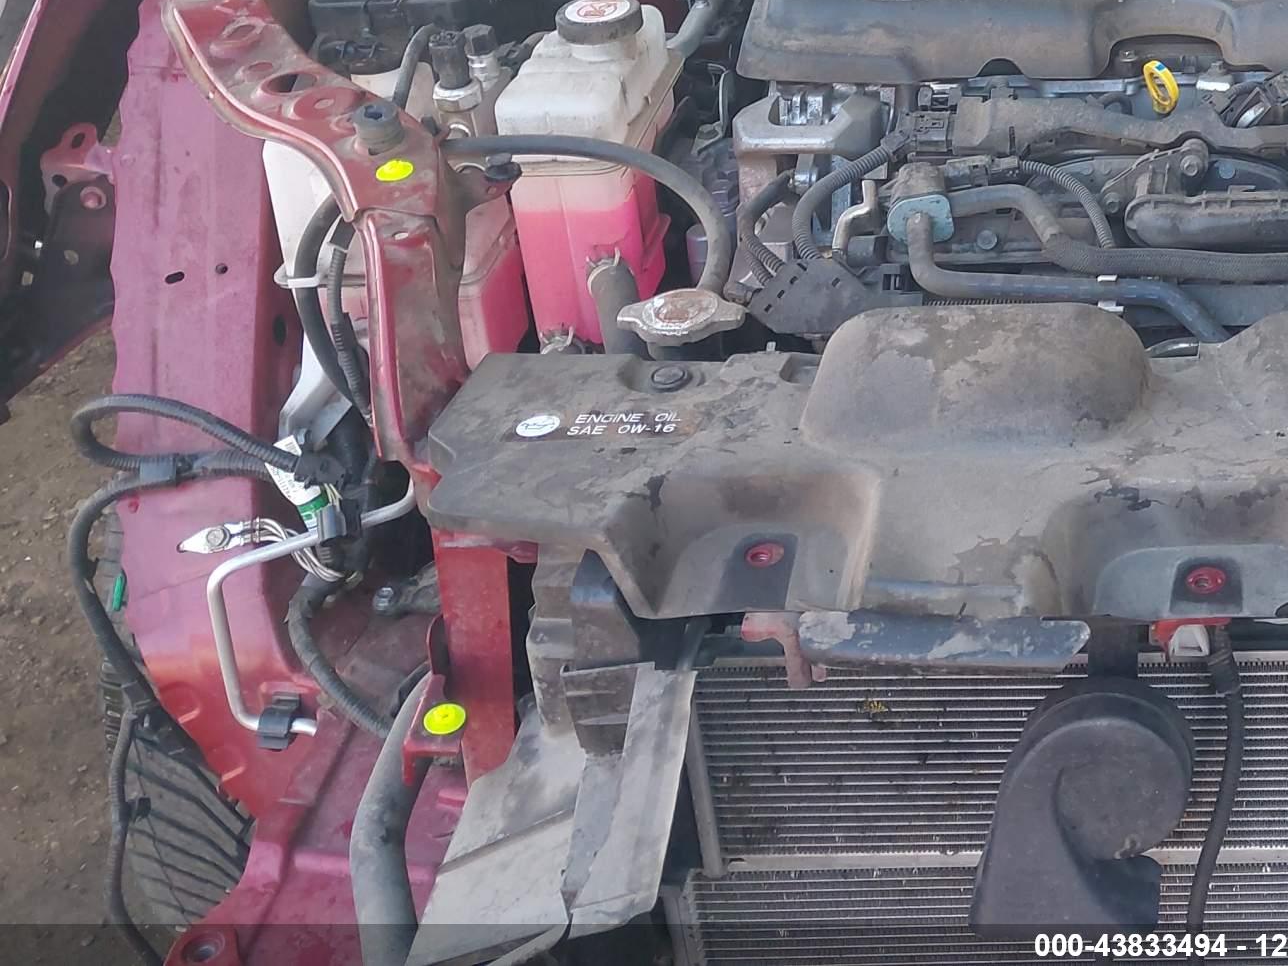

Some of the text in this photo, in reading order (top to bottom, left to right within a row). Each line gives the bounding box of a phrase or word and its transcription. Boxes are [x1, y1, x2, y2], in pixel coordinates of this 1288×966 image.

[574, 412, 682, 423] ENGINE OIL
[566, 425, 607, 436] SAE
